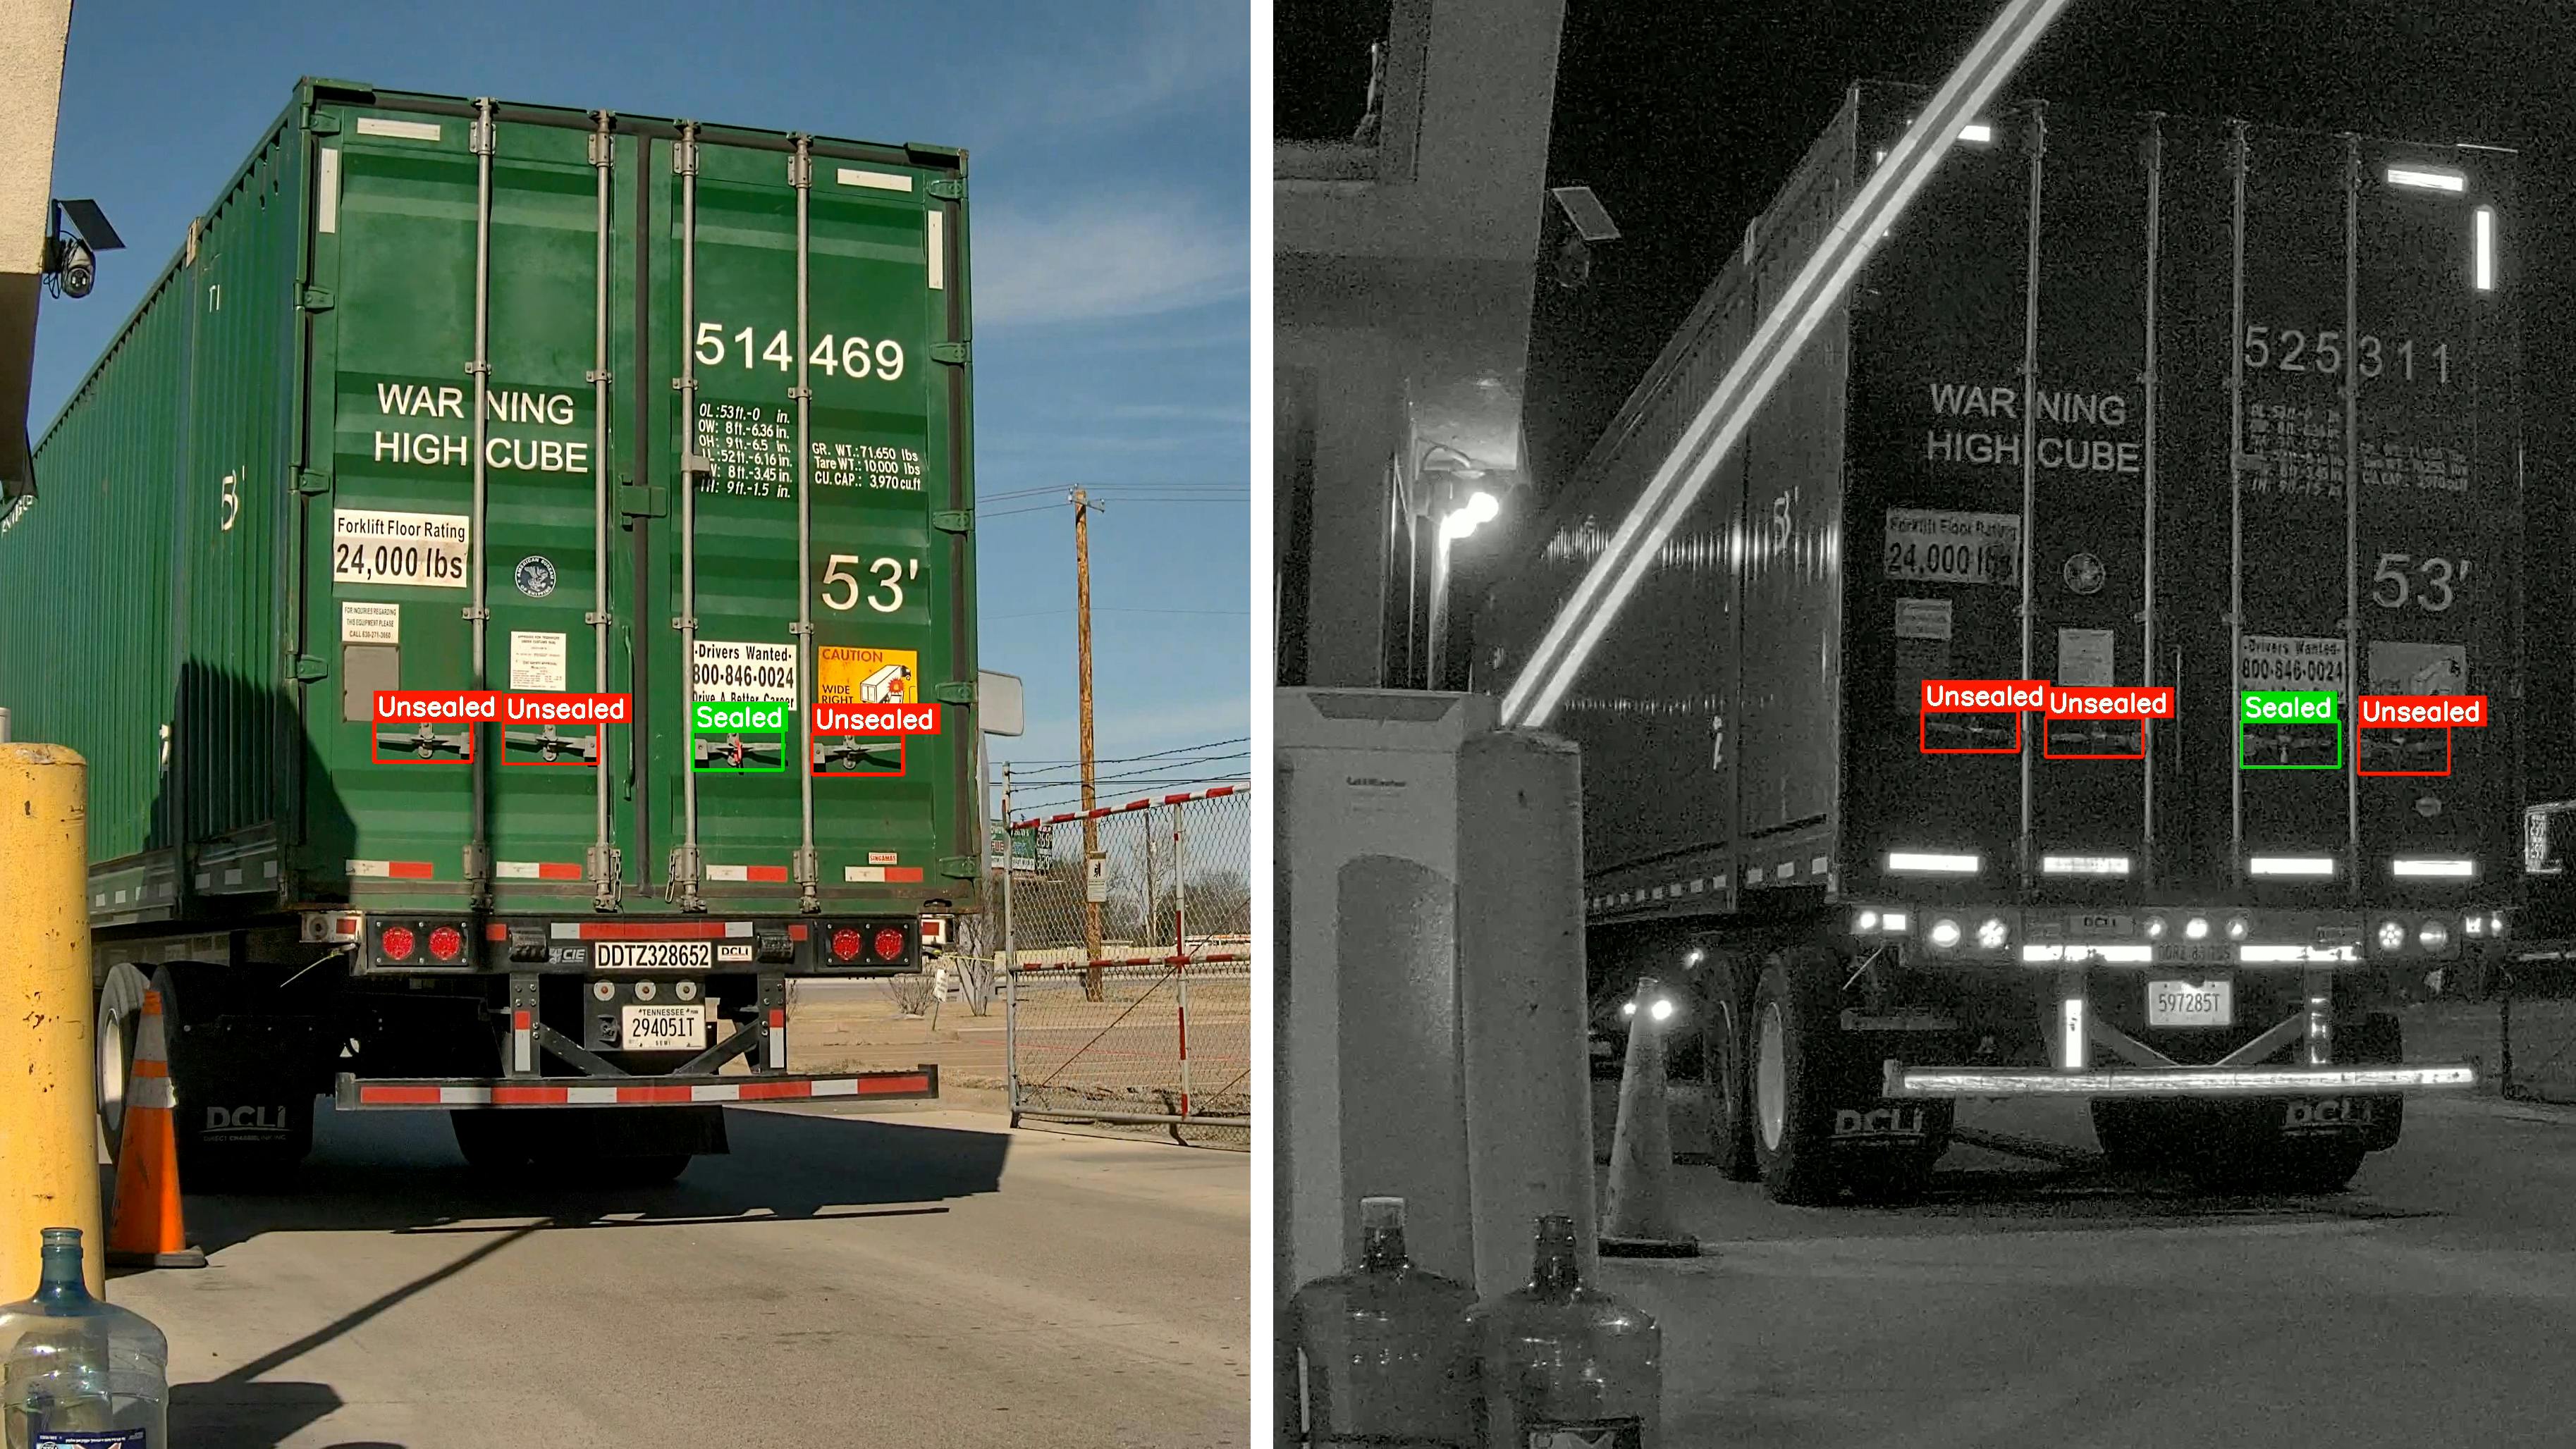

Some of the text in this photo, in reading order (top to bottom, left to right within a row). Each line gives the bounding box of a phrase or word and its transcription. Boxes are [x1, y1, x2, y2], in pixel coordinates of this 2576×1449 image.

[2245, 326, 2447, 383] 525311
[776, 409, 790, 424] in.
[699, 419, 718, 433] OW:
[775, 425, 790, 439] in.
[374, 431, 588, 474] HIGH CUBE
[699, 434, 720, 448] OH:
[776, 440, 791, 453] in.
[811, 443, 831, 455] GR.
[901, 448, 919, 462] lbs
[1927, 431, 2140, 473] HIGH CUBE
[778, 454, 792, 467] in.
[814, 456, 837, 469] Tare
[864, 460, 898, 474] 10,000
[904, 462, 921, 476] lbs
[779, 469, 792, 483] in.
[869, 474, 899, 489] 3,970
[777, 485, 790, 498] in.
[338, 517, 466, 543] Forklift Floor Rating
[336, 543, 463, 581] 24,000 lbs
[821, 554, 919, 613] 53'
[2372, 553, 2470, 612] 53'
[822, 648, 883, 662] CAUTION
[821, 684, 850, 695] WIDE
[821, 696, 854, 704] RIGHT
[563, 949, 585, 960] CIE
[598, 944, 709, 967] DDTZ328652
[2158, 993, 2220, 1013] 597285T
[632, 1018, 694, 1037] 294051T
